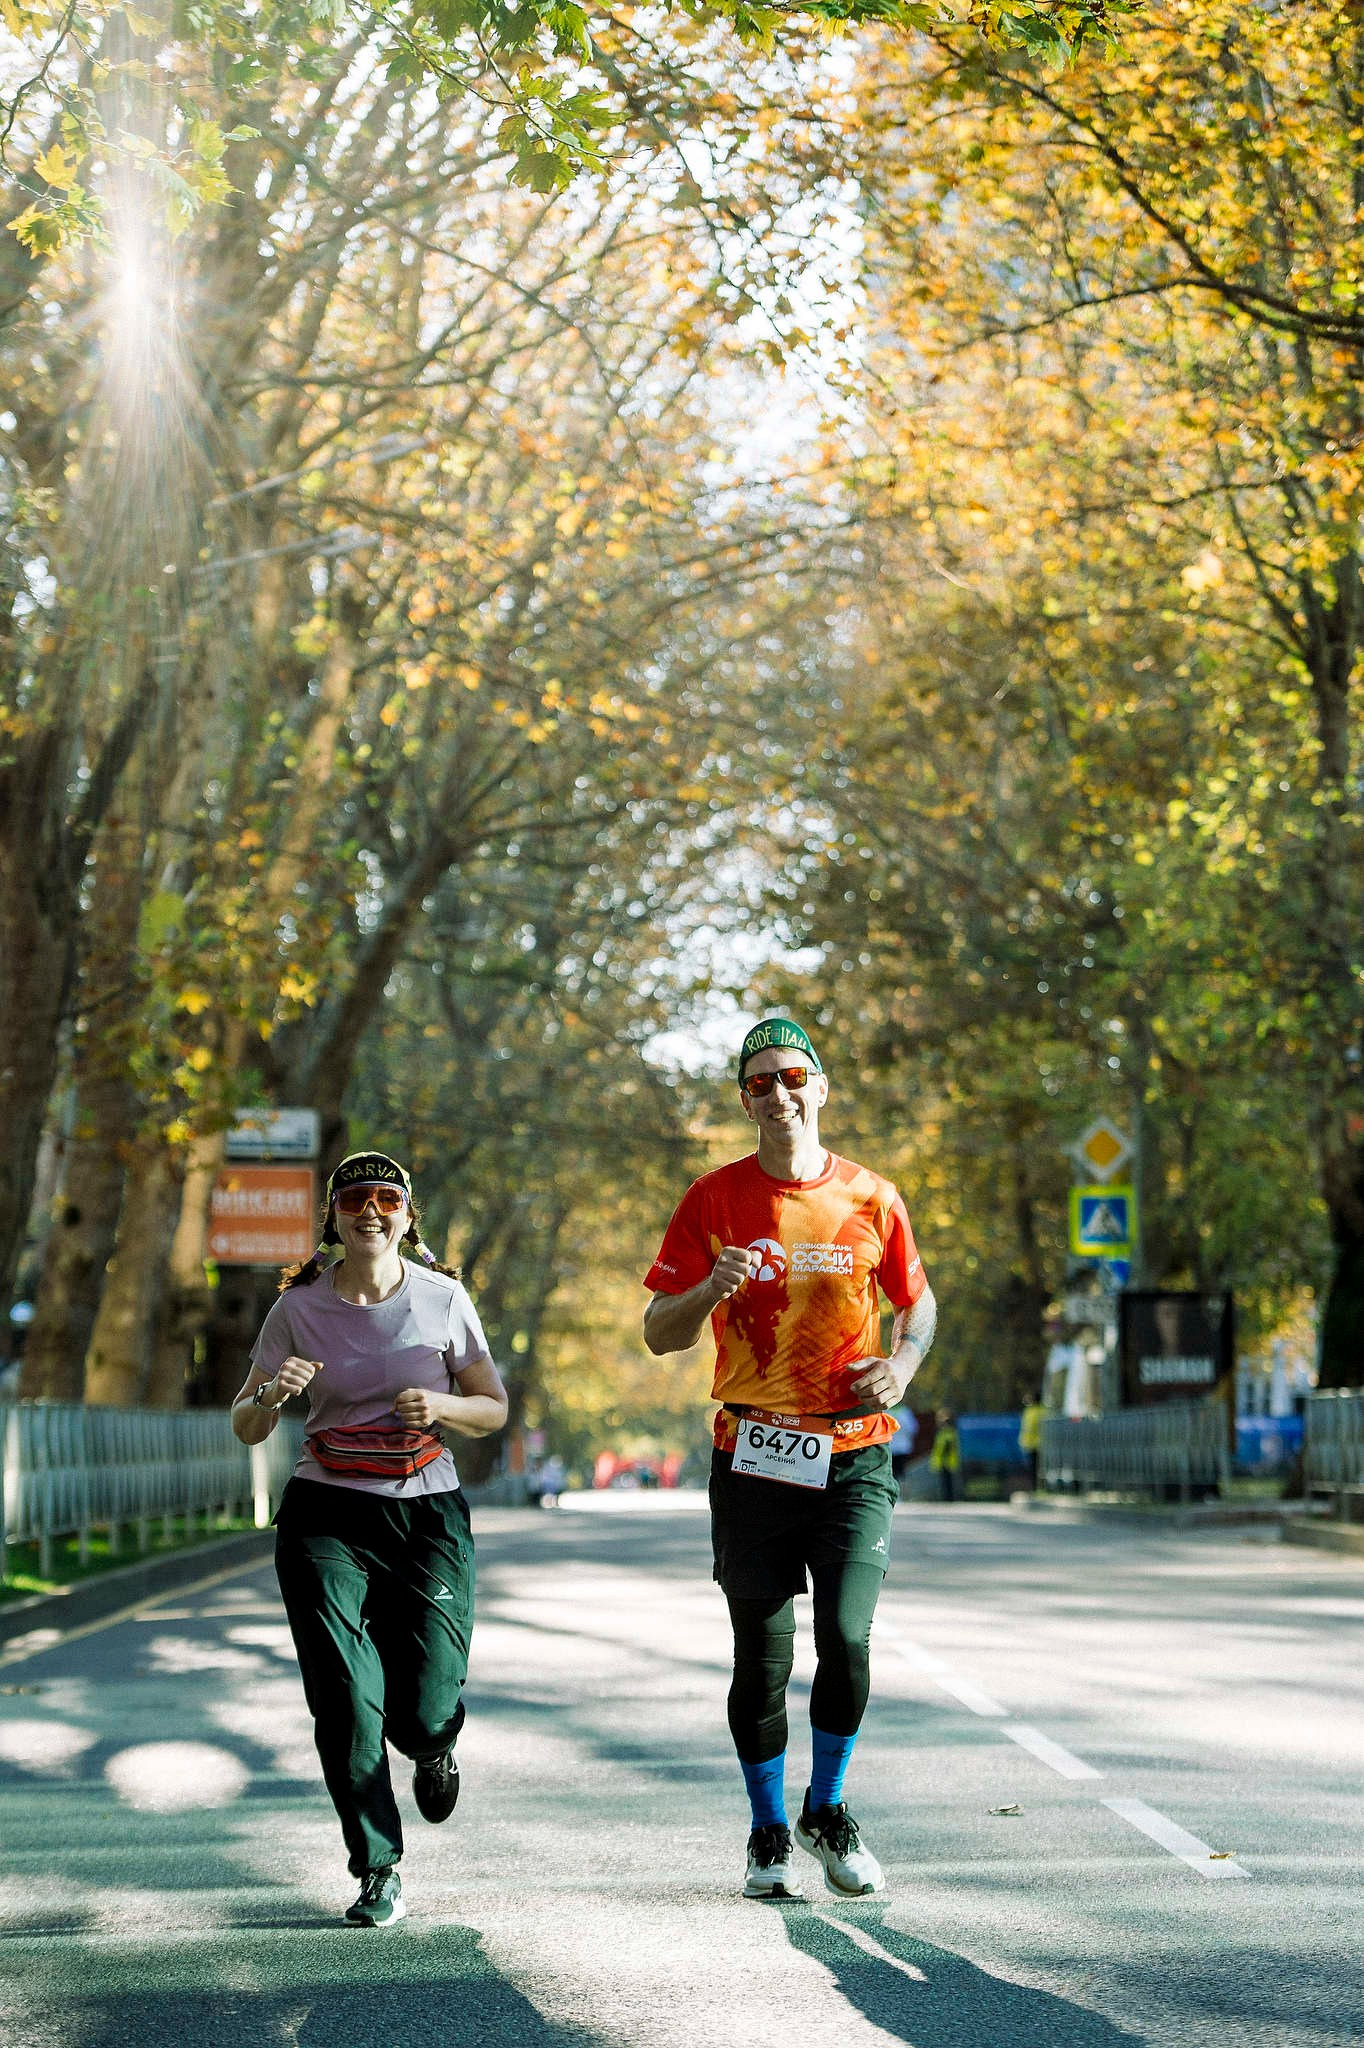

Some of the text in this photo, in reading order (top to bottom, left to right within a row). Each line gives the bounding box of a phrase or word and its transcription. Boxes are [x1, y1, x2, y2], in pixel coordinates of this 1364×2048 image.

[745, 1026, 773, 1053] RIDE
[340, 1163, 397, 1181] GARVA
[792, 1243, 853, 1252] СОВКОМБАНК
[791, 1250, 853, 1267] СОЧИ
[791, 1265, 853, 1276] МАРАФОН
[749, 1425, 821, 1460] 6470
[765, 1453, 796, 1466] АРСЕНИЙ
